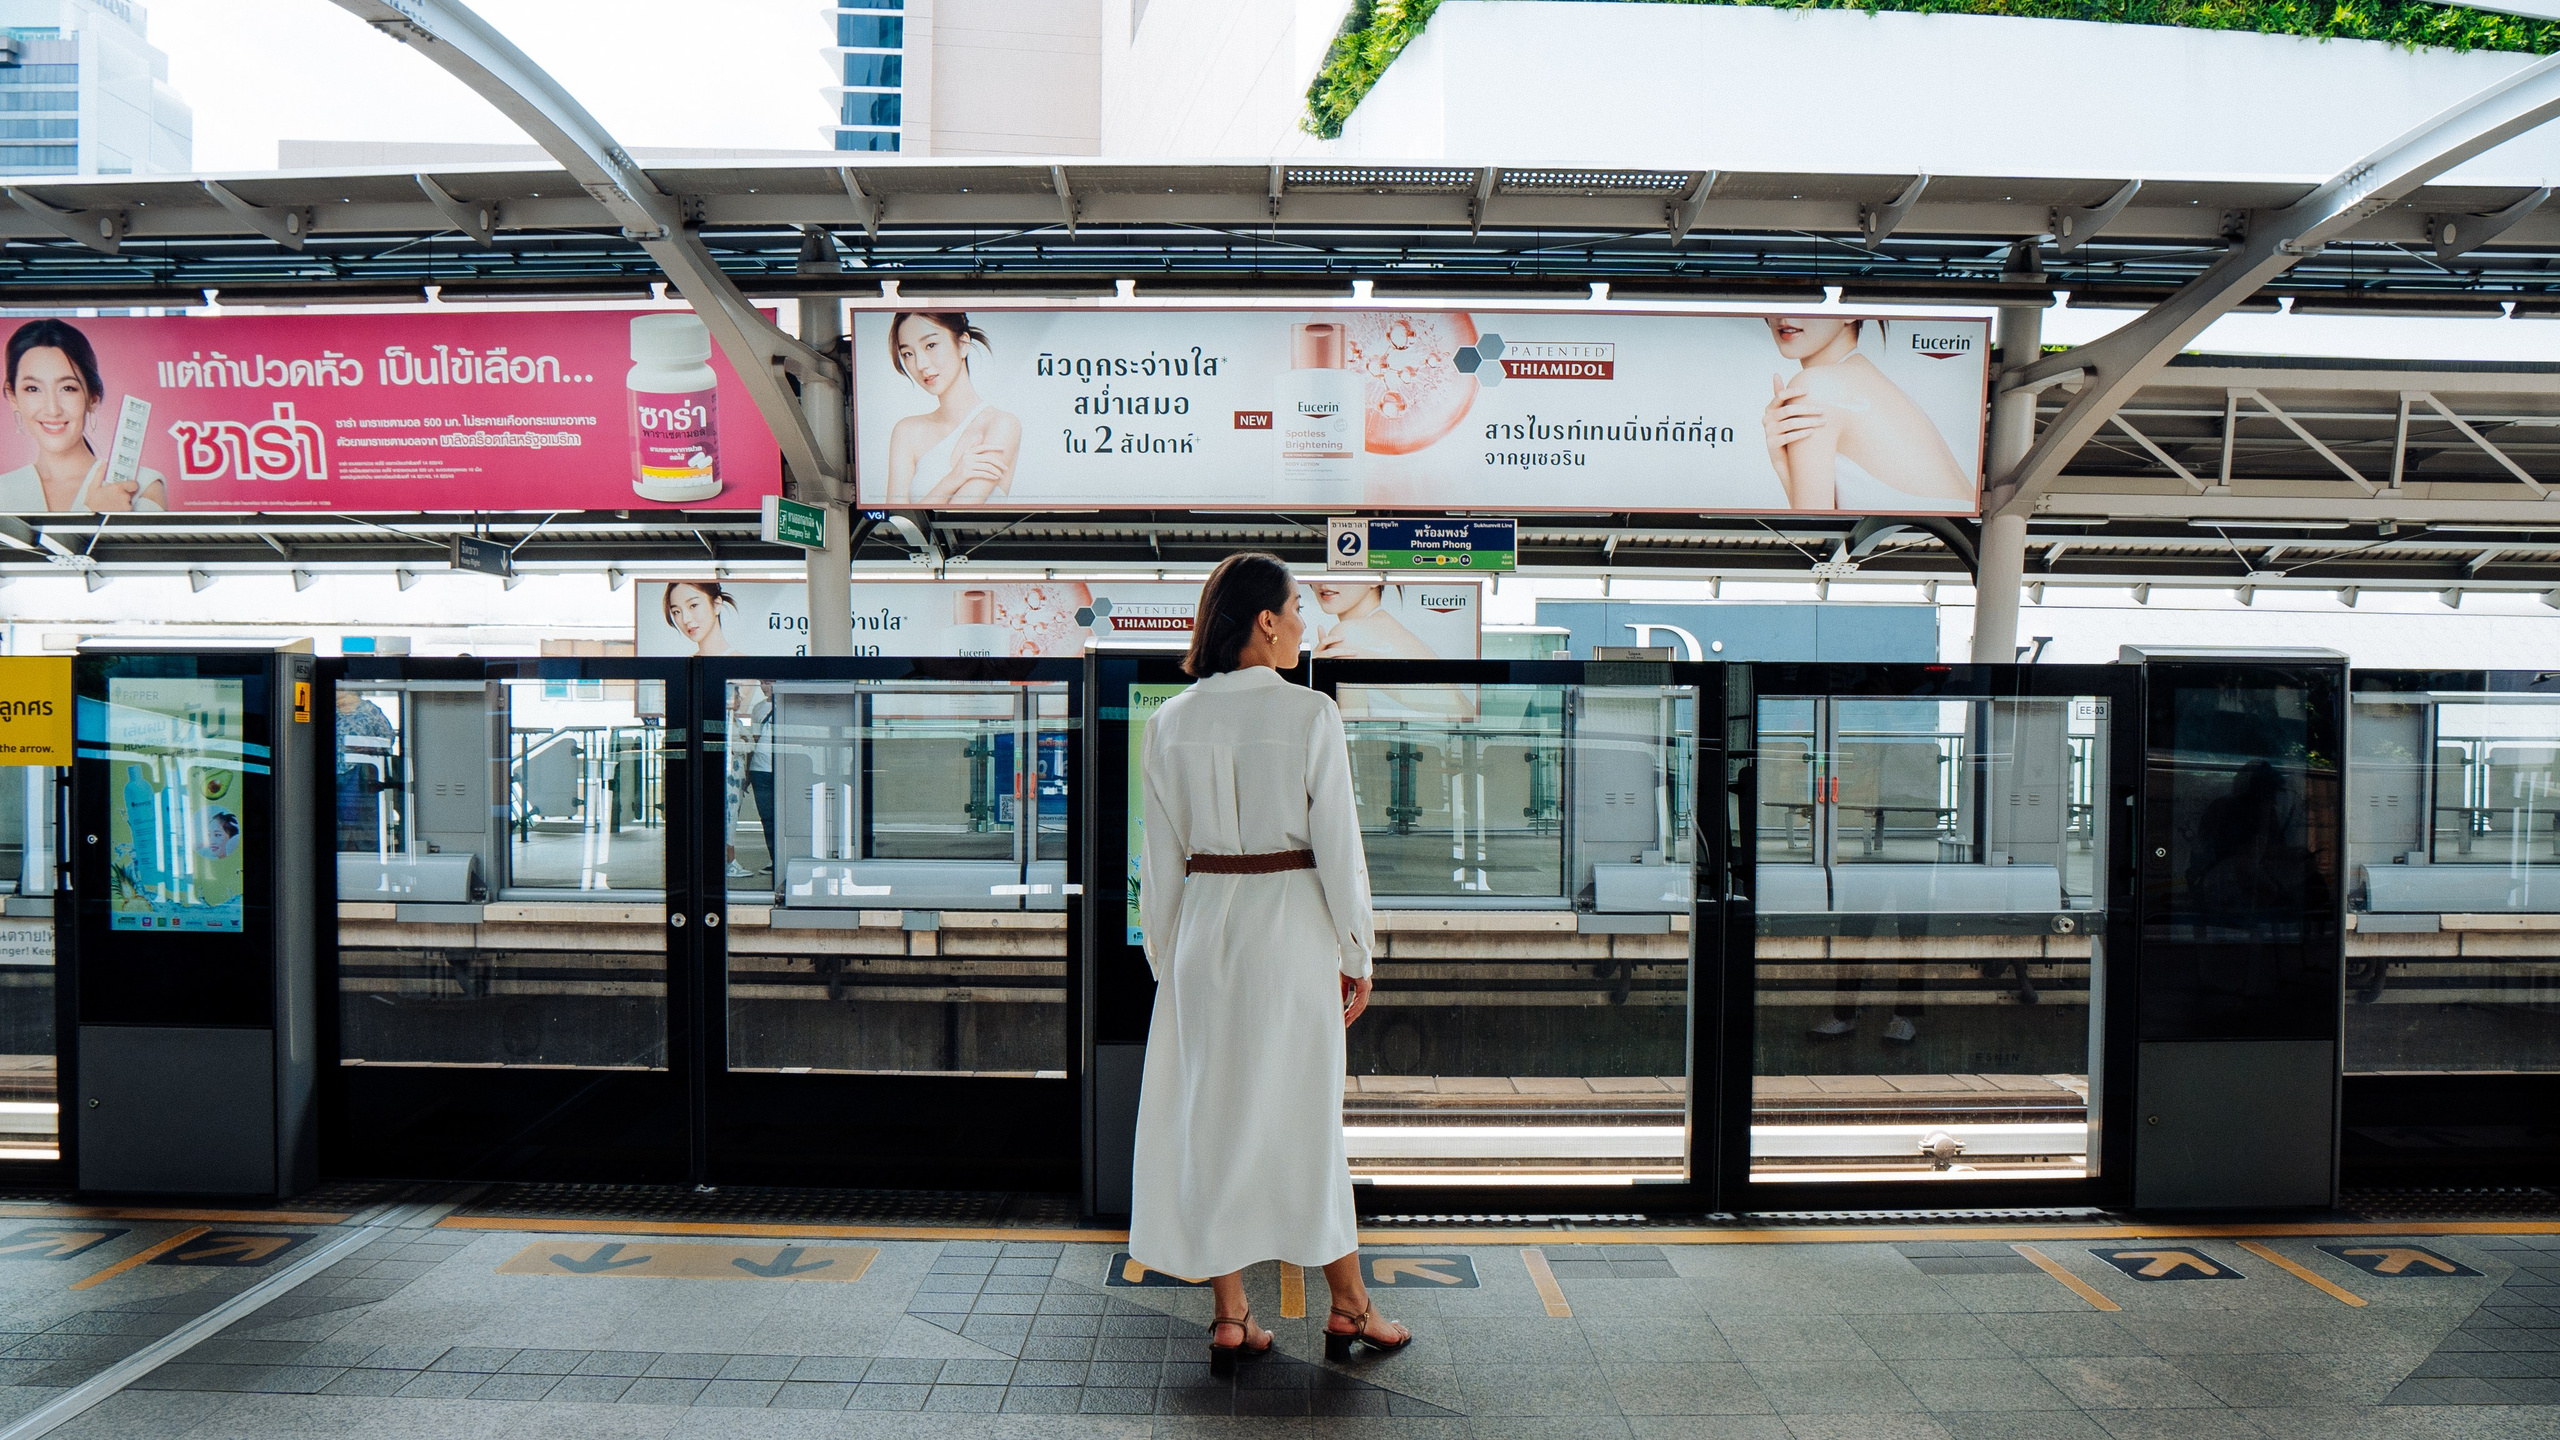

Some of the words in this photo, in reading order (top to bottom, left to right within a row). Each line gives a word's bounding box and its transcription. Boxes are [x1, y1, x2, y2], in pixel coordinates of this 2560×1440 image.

[1911, 333, 1971, 350] Eucerin
[1511, 346, 1606, 357] PATENTED
[157, 350, 364, 388] แต่ถ้าปวดหัว
[378, 344, 593, 385] เป็นไข้เลือก...
[1510, 363, 1606, 376] THIAMIDOL
[1074, 383, 1190, 415] สม่ำเสมอ
[1297, 401, 1340, 413] Eucerin
[638, 399, 707, 431] ซาร่า
[1239, 415, 1268, 426] NEW
[423, 418, 442, 427] 500
[1285, 430, 1326, 439] Spotless
[1485, 414, 1735, 448] สารไบรท์เทนนิ่งที่ดีที่สุด
[167, 401, 328, 481] ซาร่า
[1063, 428, 1087, 454] ใน
[1094, 425, 1113, 454] 2
[1285, 440, 1343, 450] Brightening
[1484, 449, 1586, 471] จากยูเซอริน
[867, 511, 886, 520] VGI
[1331, 521, 1367, 529] ชานชาลา
[1414, 524, 1470, 538] พร้อมพงษ์
[1341, 533, 1356, 554] 2
[1410, 540, 1440, 549] Phrom
[1442, 540, 1472, 550] Phong
[1420, 594, 1467, 607] Eucerin
[1117, 605, 1188, 615] PATENTED
[1116, 618, 1189, 629] THIAMIDOL
[958, 648, 991, 657] Eucerin
[2079, 706, 2105, 715] EE-03
[0, 744, 17, 753] the
[19, 745, 55, 753] arrow.
